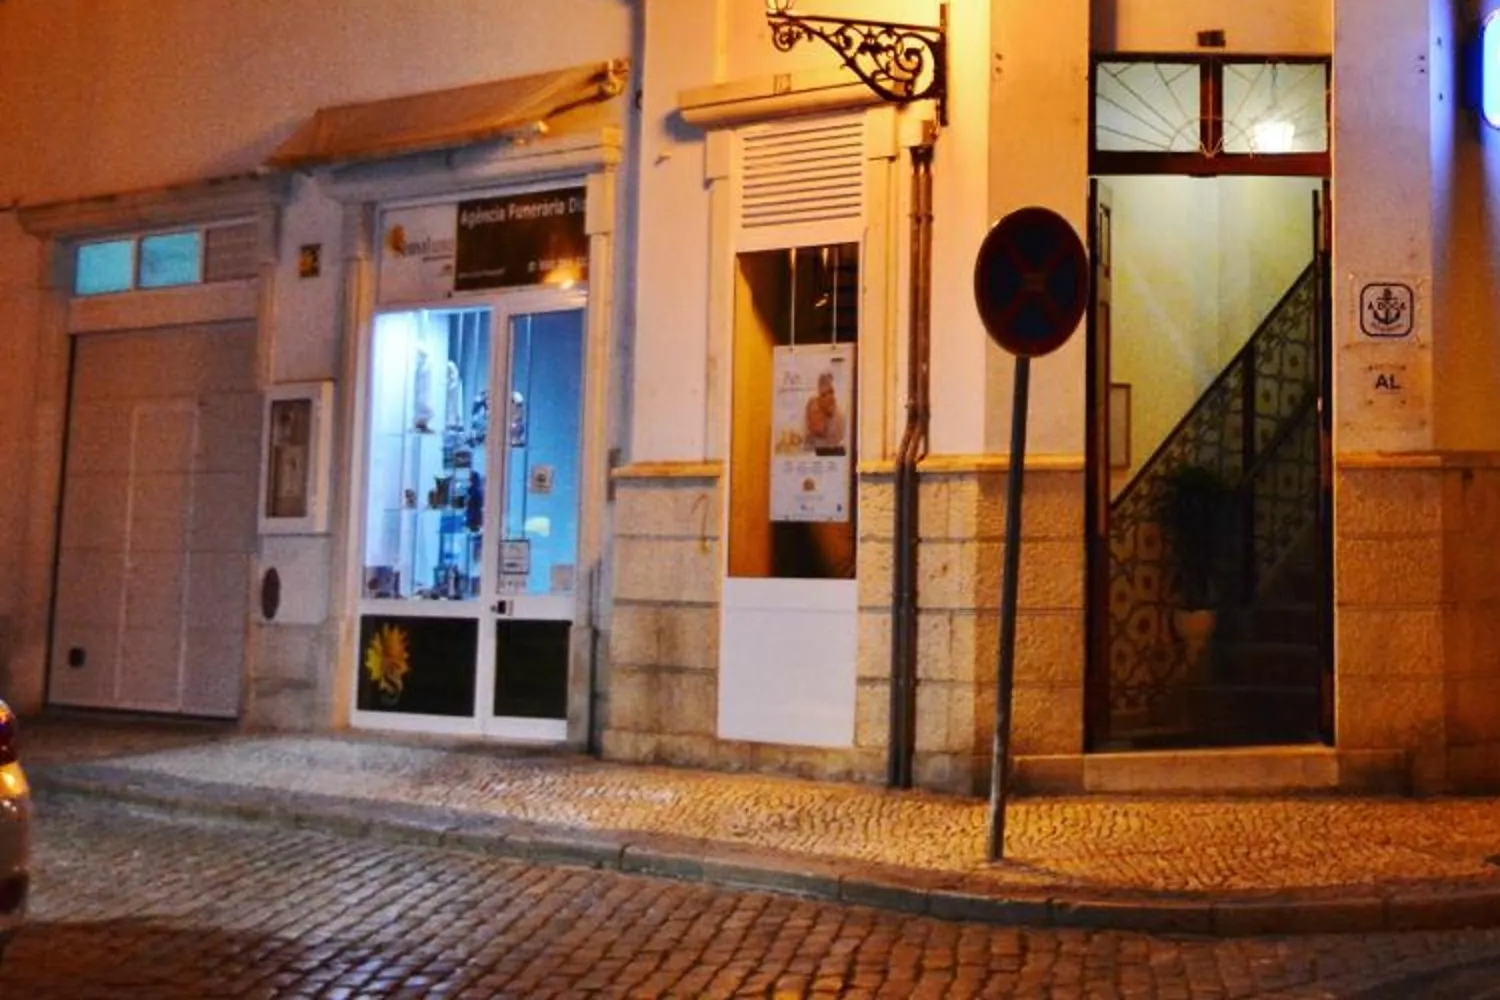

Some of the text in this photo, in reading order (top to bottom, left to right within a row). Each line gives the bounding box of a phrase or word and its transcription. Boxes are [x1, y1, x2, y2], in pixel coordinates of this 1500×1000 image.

[460, 206, 506, 230] Agência
[509, 199, 566, 220] Funerária
[1375, 373, 1401, 389] AL
